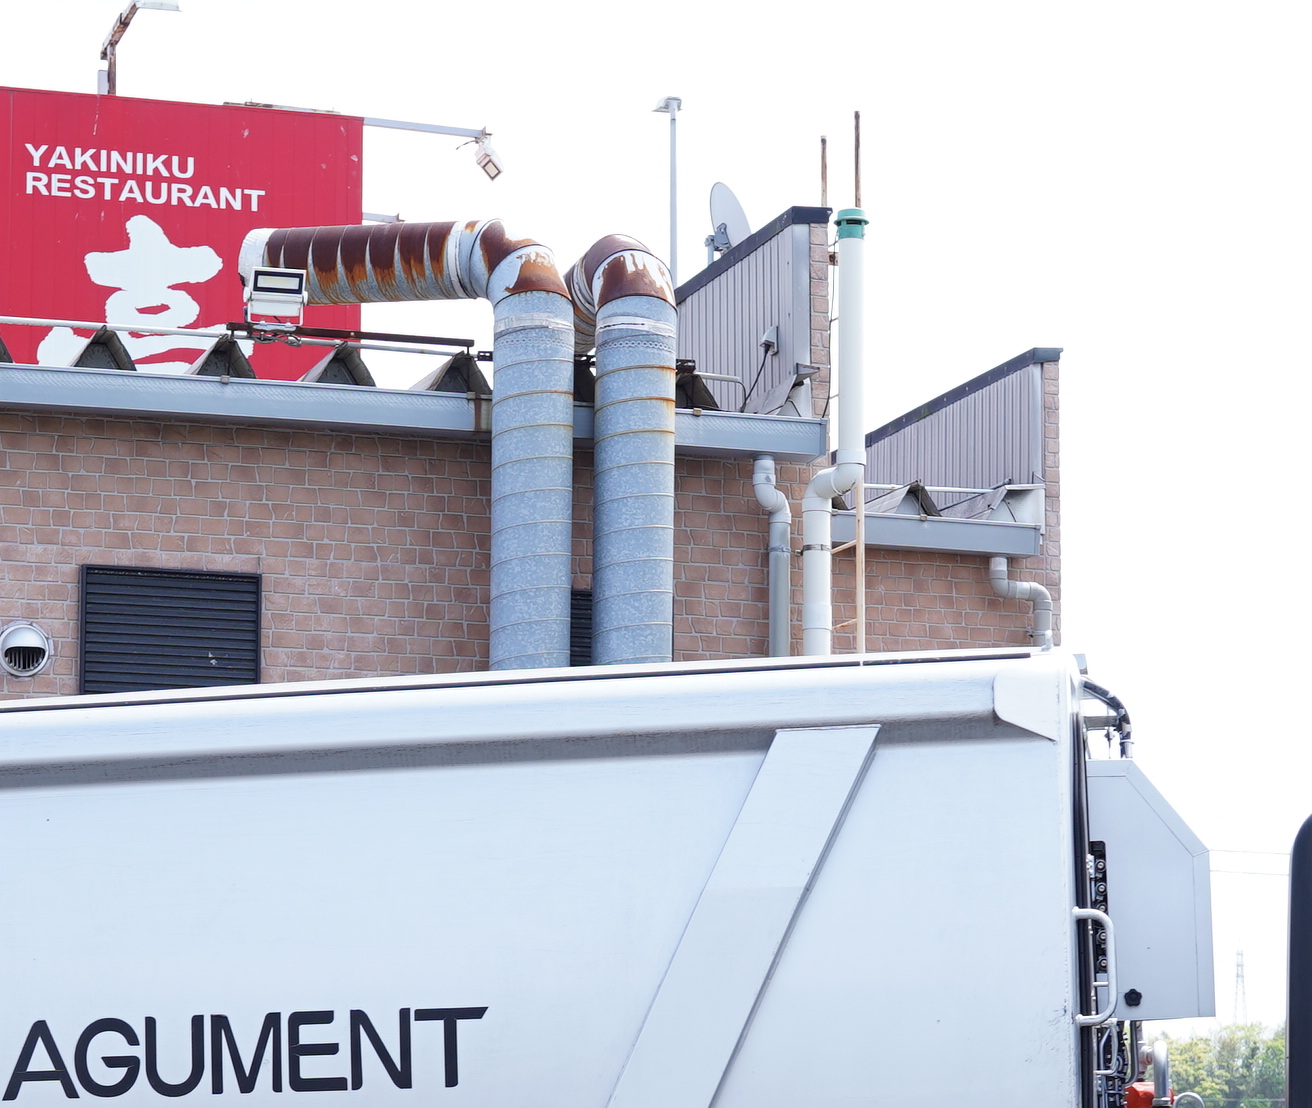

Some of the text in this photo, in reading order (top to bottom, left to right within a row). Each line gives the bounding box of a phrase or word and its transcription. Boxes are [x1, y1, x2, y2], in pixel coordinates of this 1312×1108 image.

[24, 143, 196, 179] YAKINIKU
[25, 171, 266, 213] RESTAURANT
[1, 1006, 490, 1102] AGUMENT
